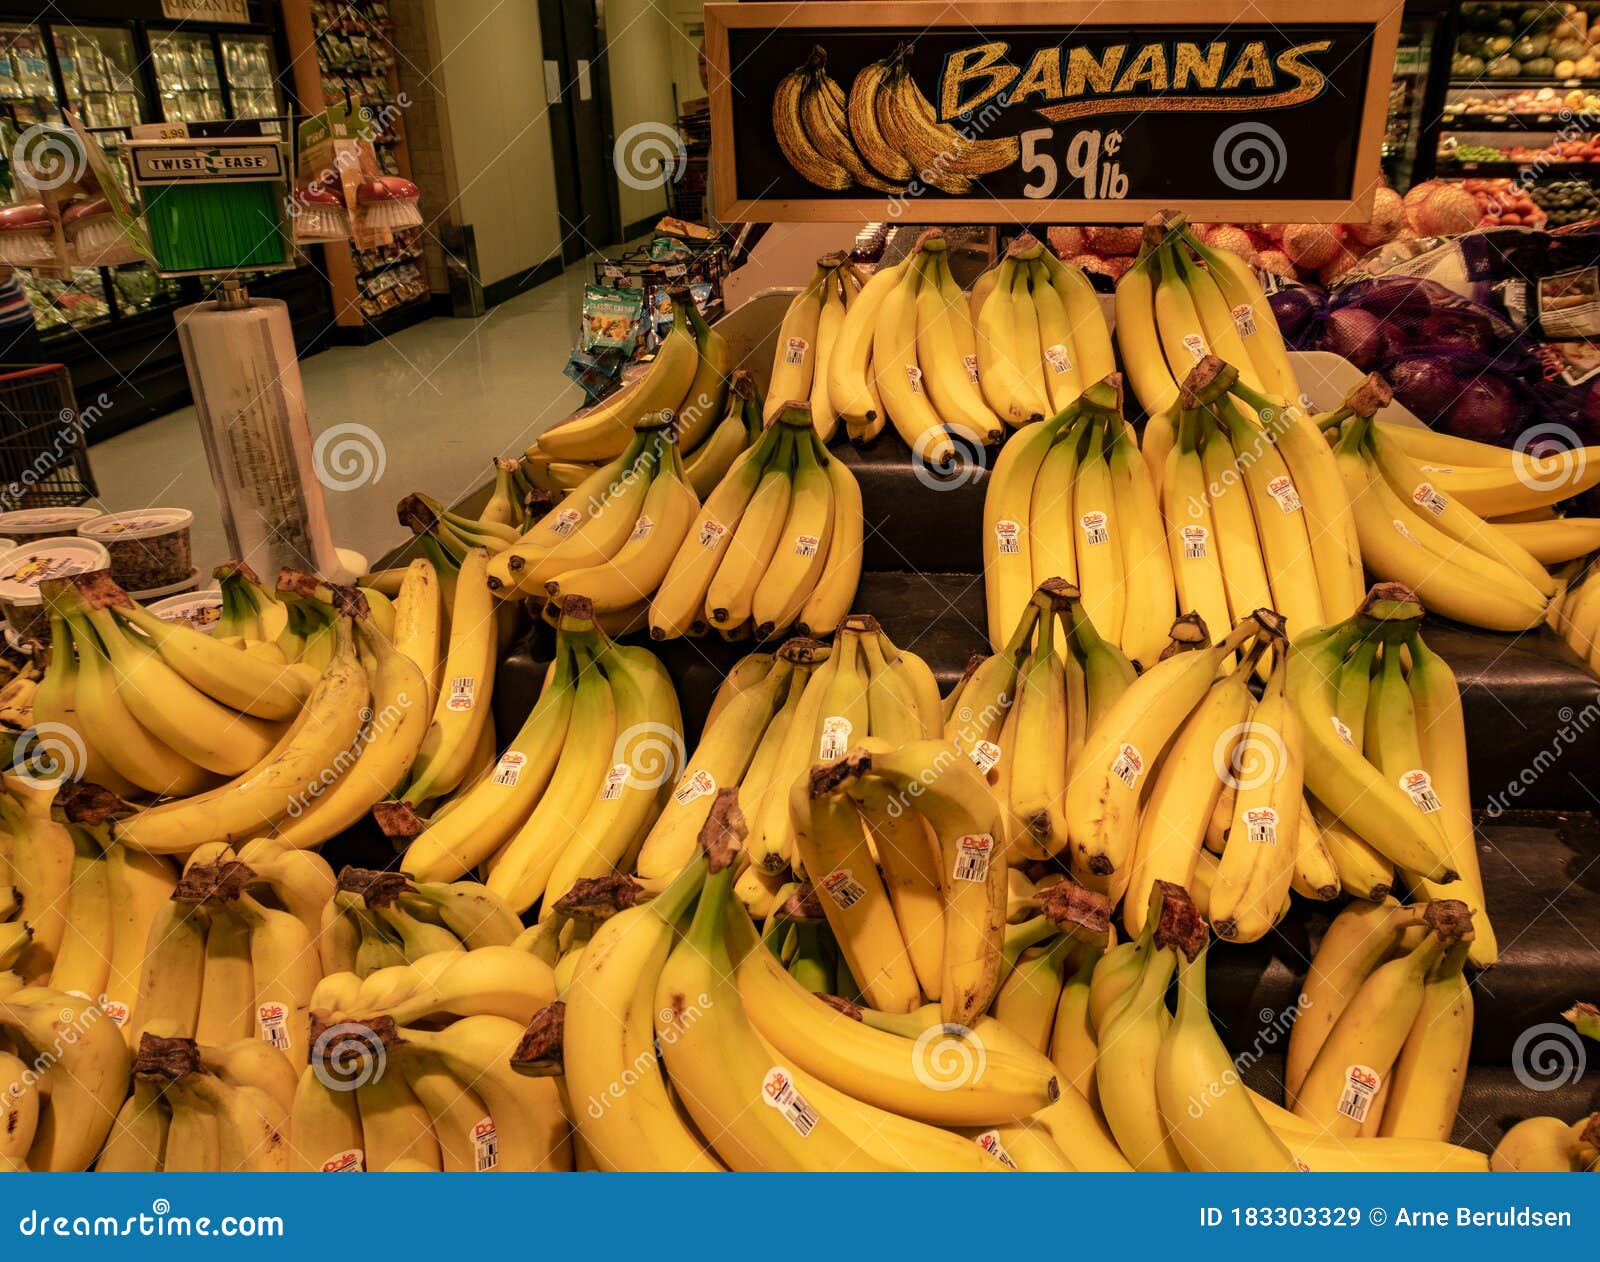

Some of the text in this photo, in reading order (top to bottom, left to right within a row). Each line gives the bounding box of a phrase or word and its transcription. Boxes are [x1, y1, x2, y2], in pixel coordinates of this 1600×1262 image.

[937, 40, 1331, 122] BANANAS
[160, 129, 185, 139] 3.99
[152, 158, 202, 170] TWIST
[1099, 162, 1129, 199] lb
[1269, 478, 1289, 491] Dole
[1083, 513, 1103, 524] Dole
[996, 522, 1016, 531] Dole
[1184, 527, 1203, 536] Dole
[501, 754, 523, 763] Dole
[1124, 745, 1141, 769] Dole
[1248, 809, 1274, 820] Dole
[962, 836, 989, 849] Dole
[260, 1006, 284, 1018] Dole
[1350, 1066, 1377, 1087] Dole
[764, 1071, 785, 1097] Dole
[322, 1152, 357, 1172] Dole
